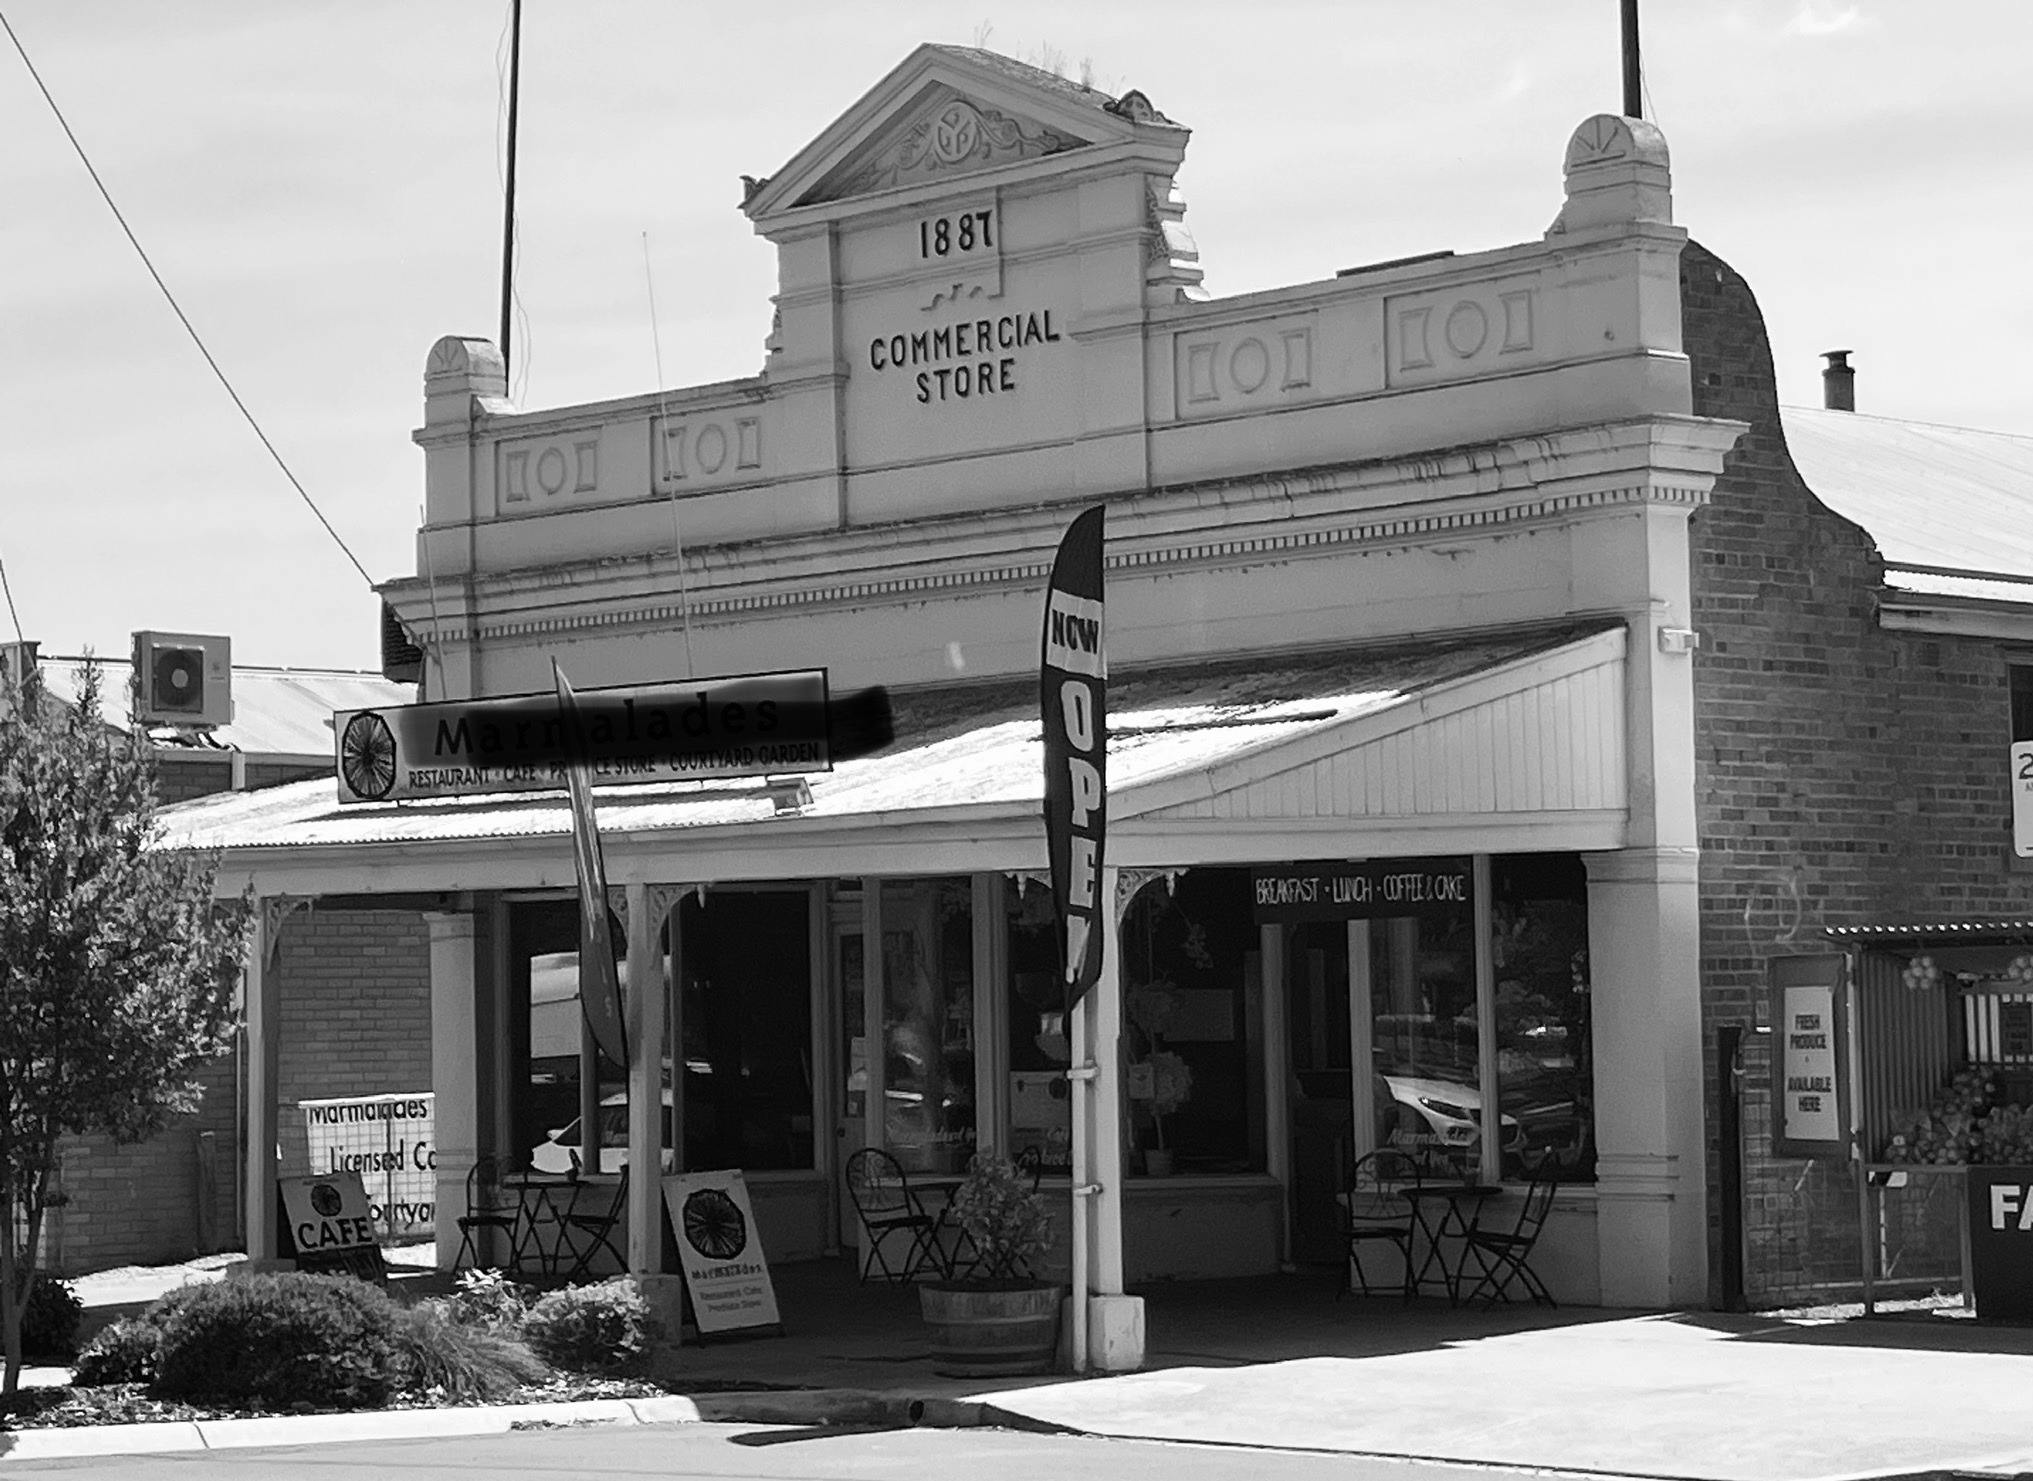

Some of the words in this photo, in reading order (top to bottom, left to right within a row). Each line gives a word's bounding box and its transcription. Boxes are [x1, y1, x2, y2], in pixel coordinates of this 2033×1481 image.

[921, 209, 992, 258] 1887
[870, 310, 1060, 371] COMMERCIAL
[916, 358, 1016, 403] STORE
[1051, 608, 1099, 654] NOW
[408, 766, 490, 788] RESTAURANT
[504, 764, 536, 782] CAFE
[550, 754, 610, 779] PRCE
[615, 753, 656, 775] STORE
[670, 745, 753, 771] COURTYARD
[759, 742, 818, 763] GARDEN
[1256, 877, 1319, 904] BREAKFAST
[1332, 876, 1372, 903] LUNCH
[1384, 873, 1424, 901] COFFEE
[1435, 875, 1466, 900] CAKE
[309, 1100, 427, 1124] Marmalades
[330, 1139, 404, 1173] Licensed
[298, 1216, 373, 1249] CAFE
